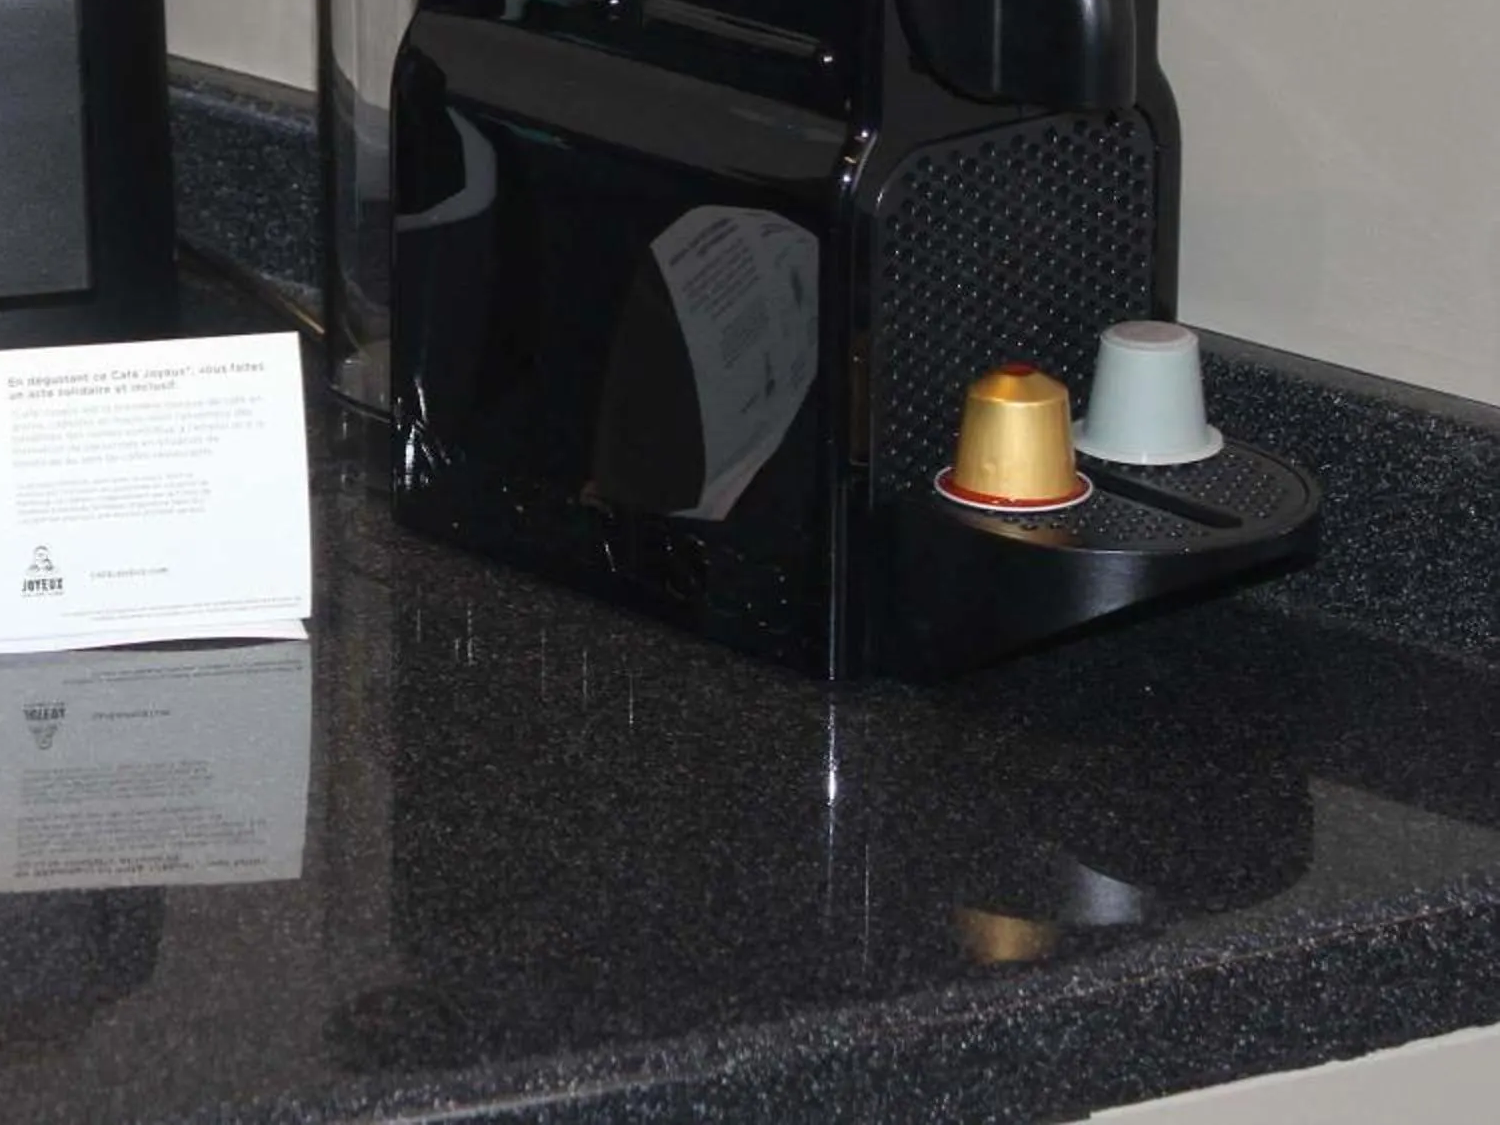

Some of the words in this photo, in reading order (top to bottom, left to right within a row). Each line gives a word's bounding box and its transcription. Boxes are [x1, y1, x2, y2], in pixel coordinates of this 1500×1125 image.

[199, 365, 228, 375] vous
[230, 361, 264, 373] faites
[57, 383, 111, 397] solidaire
[21, 577, 64, 592] JOYEUX
